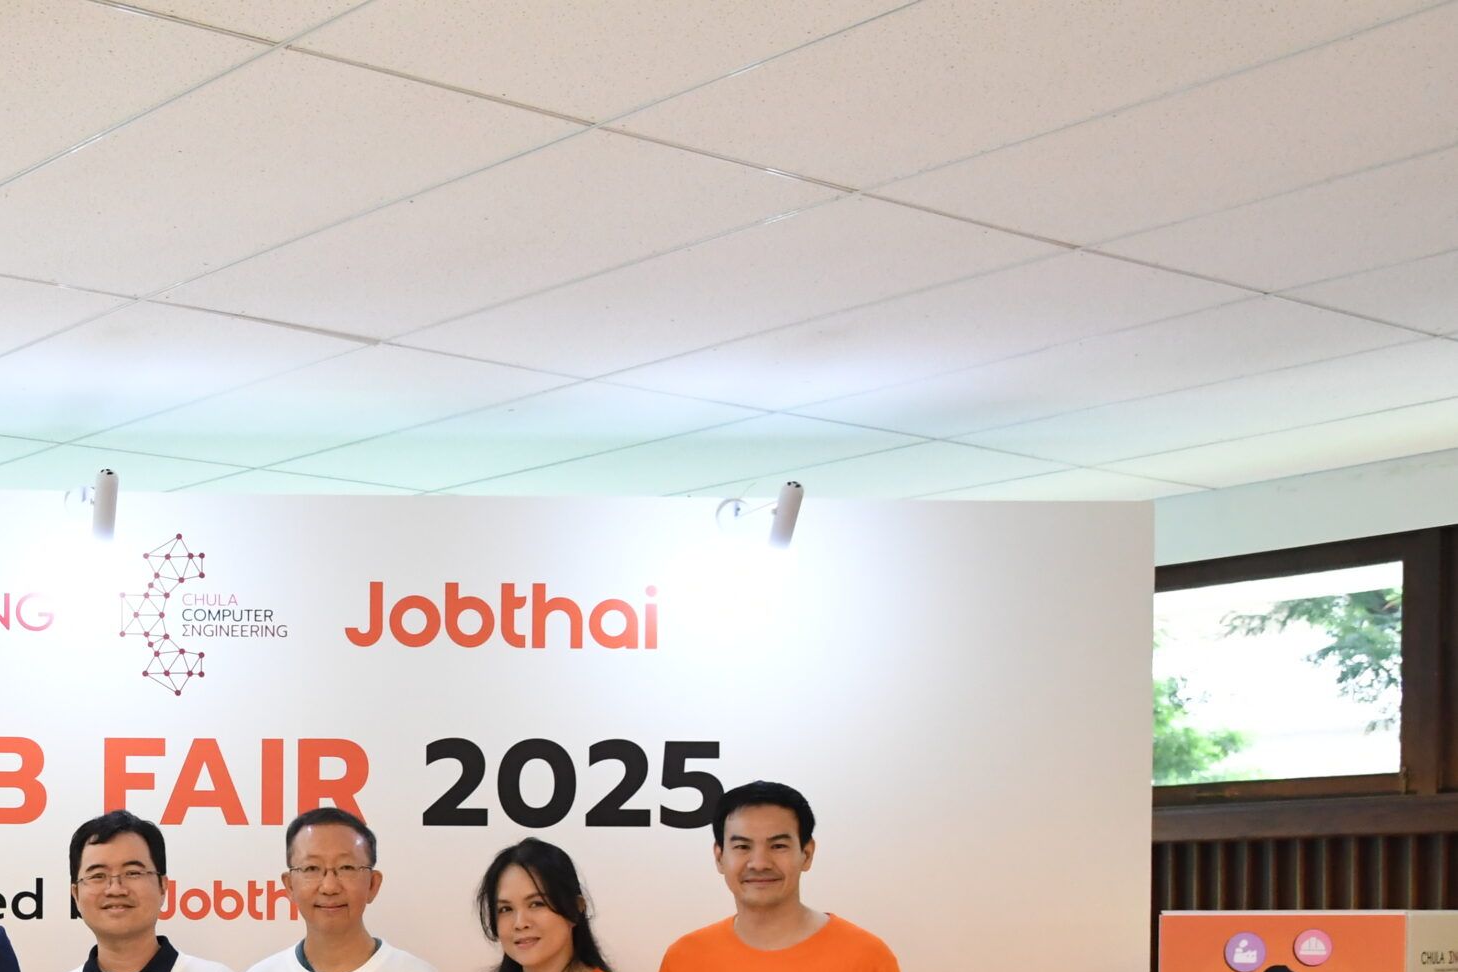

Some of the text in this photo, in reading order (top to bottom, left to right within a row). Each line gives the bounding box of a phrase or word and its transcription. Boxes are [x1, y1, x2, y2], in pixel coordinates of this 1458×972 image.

[181, 593, 238, 607] CHULA
[181, 608, 274, 623] COMPUTER
[345, 581, 658, 650] Jobthai
[103, 737, 370, 827] FAIR
[422, 737, 725, 829] 2025
[158, 880, 299, 921] Jobth
